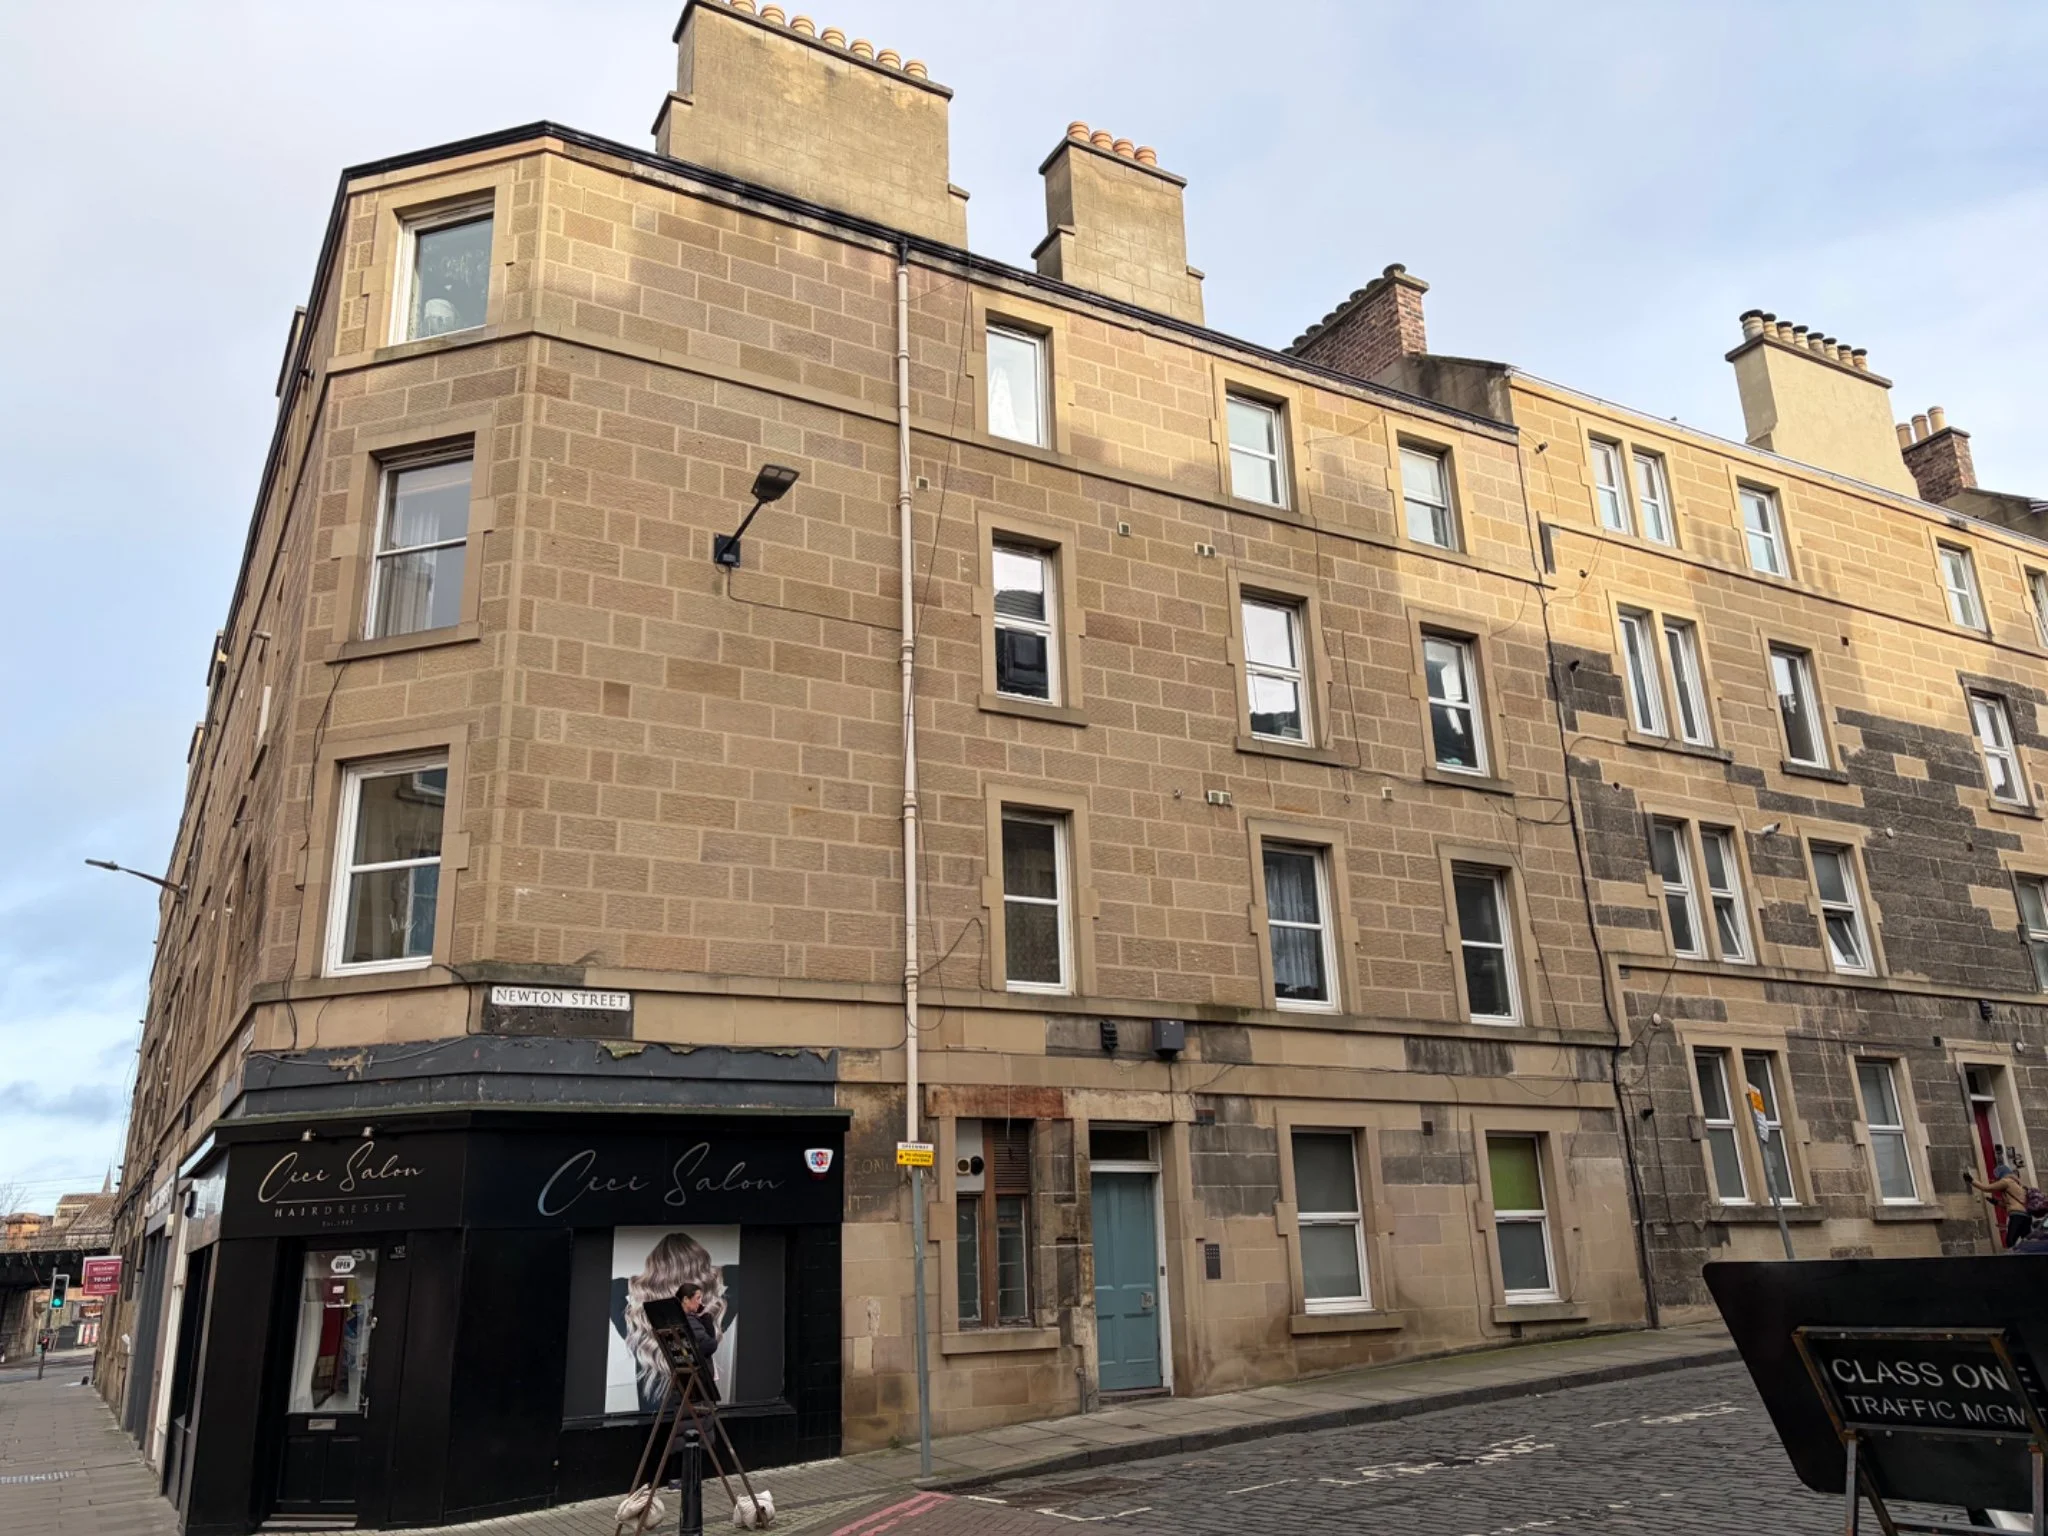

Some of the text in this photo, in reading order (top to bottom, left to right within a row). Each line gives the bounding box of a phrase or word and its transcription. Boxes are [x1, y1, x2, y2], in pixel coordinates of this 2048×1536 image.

[496, 989, 627, 1007] NEWTON STREET
[340, 1140, 425, 1192] Salon
[664, 1142, 785, 1206] Salon
[274, 1202, 406, 1218] HAIRDRESSER
[335, 1261, 351, 1270] OPEN
[1832, 1359, 1944, 1387] CLASS
[1845, 1395, 1956, 1420] TRAFFIC
